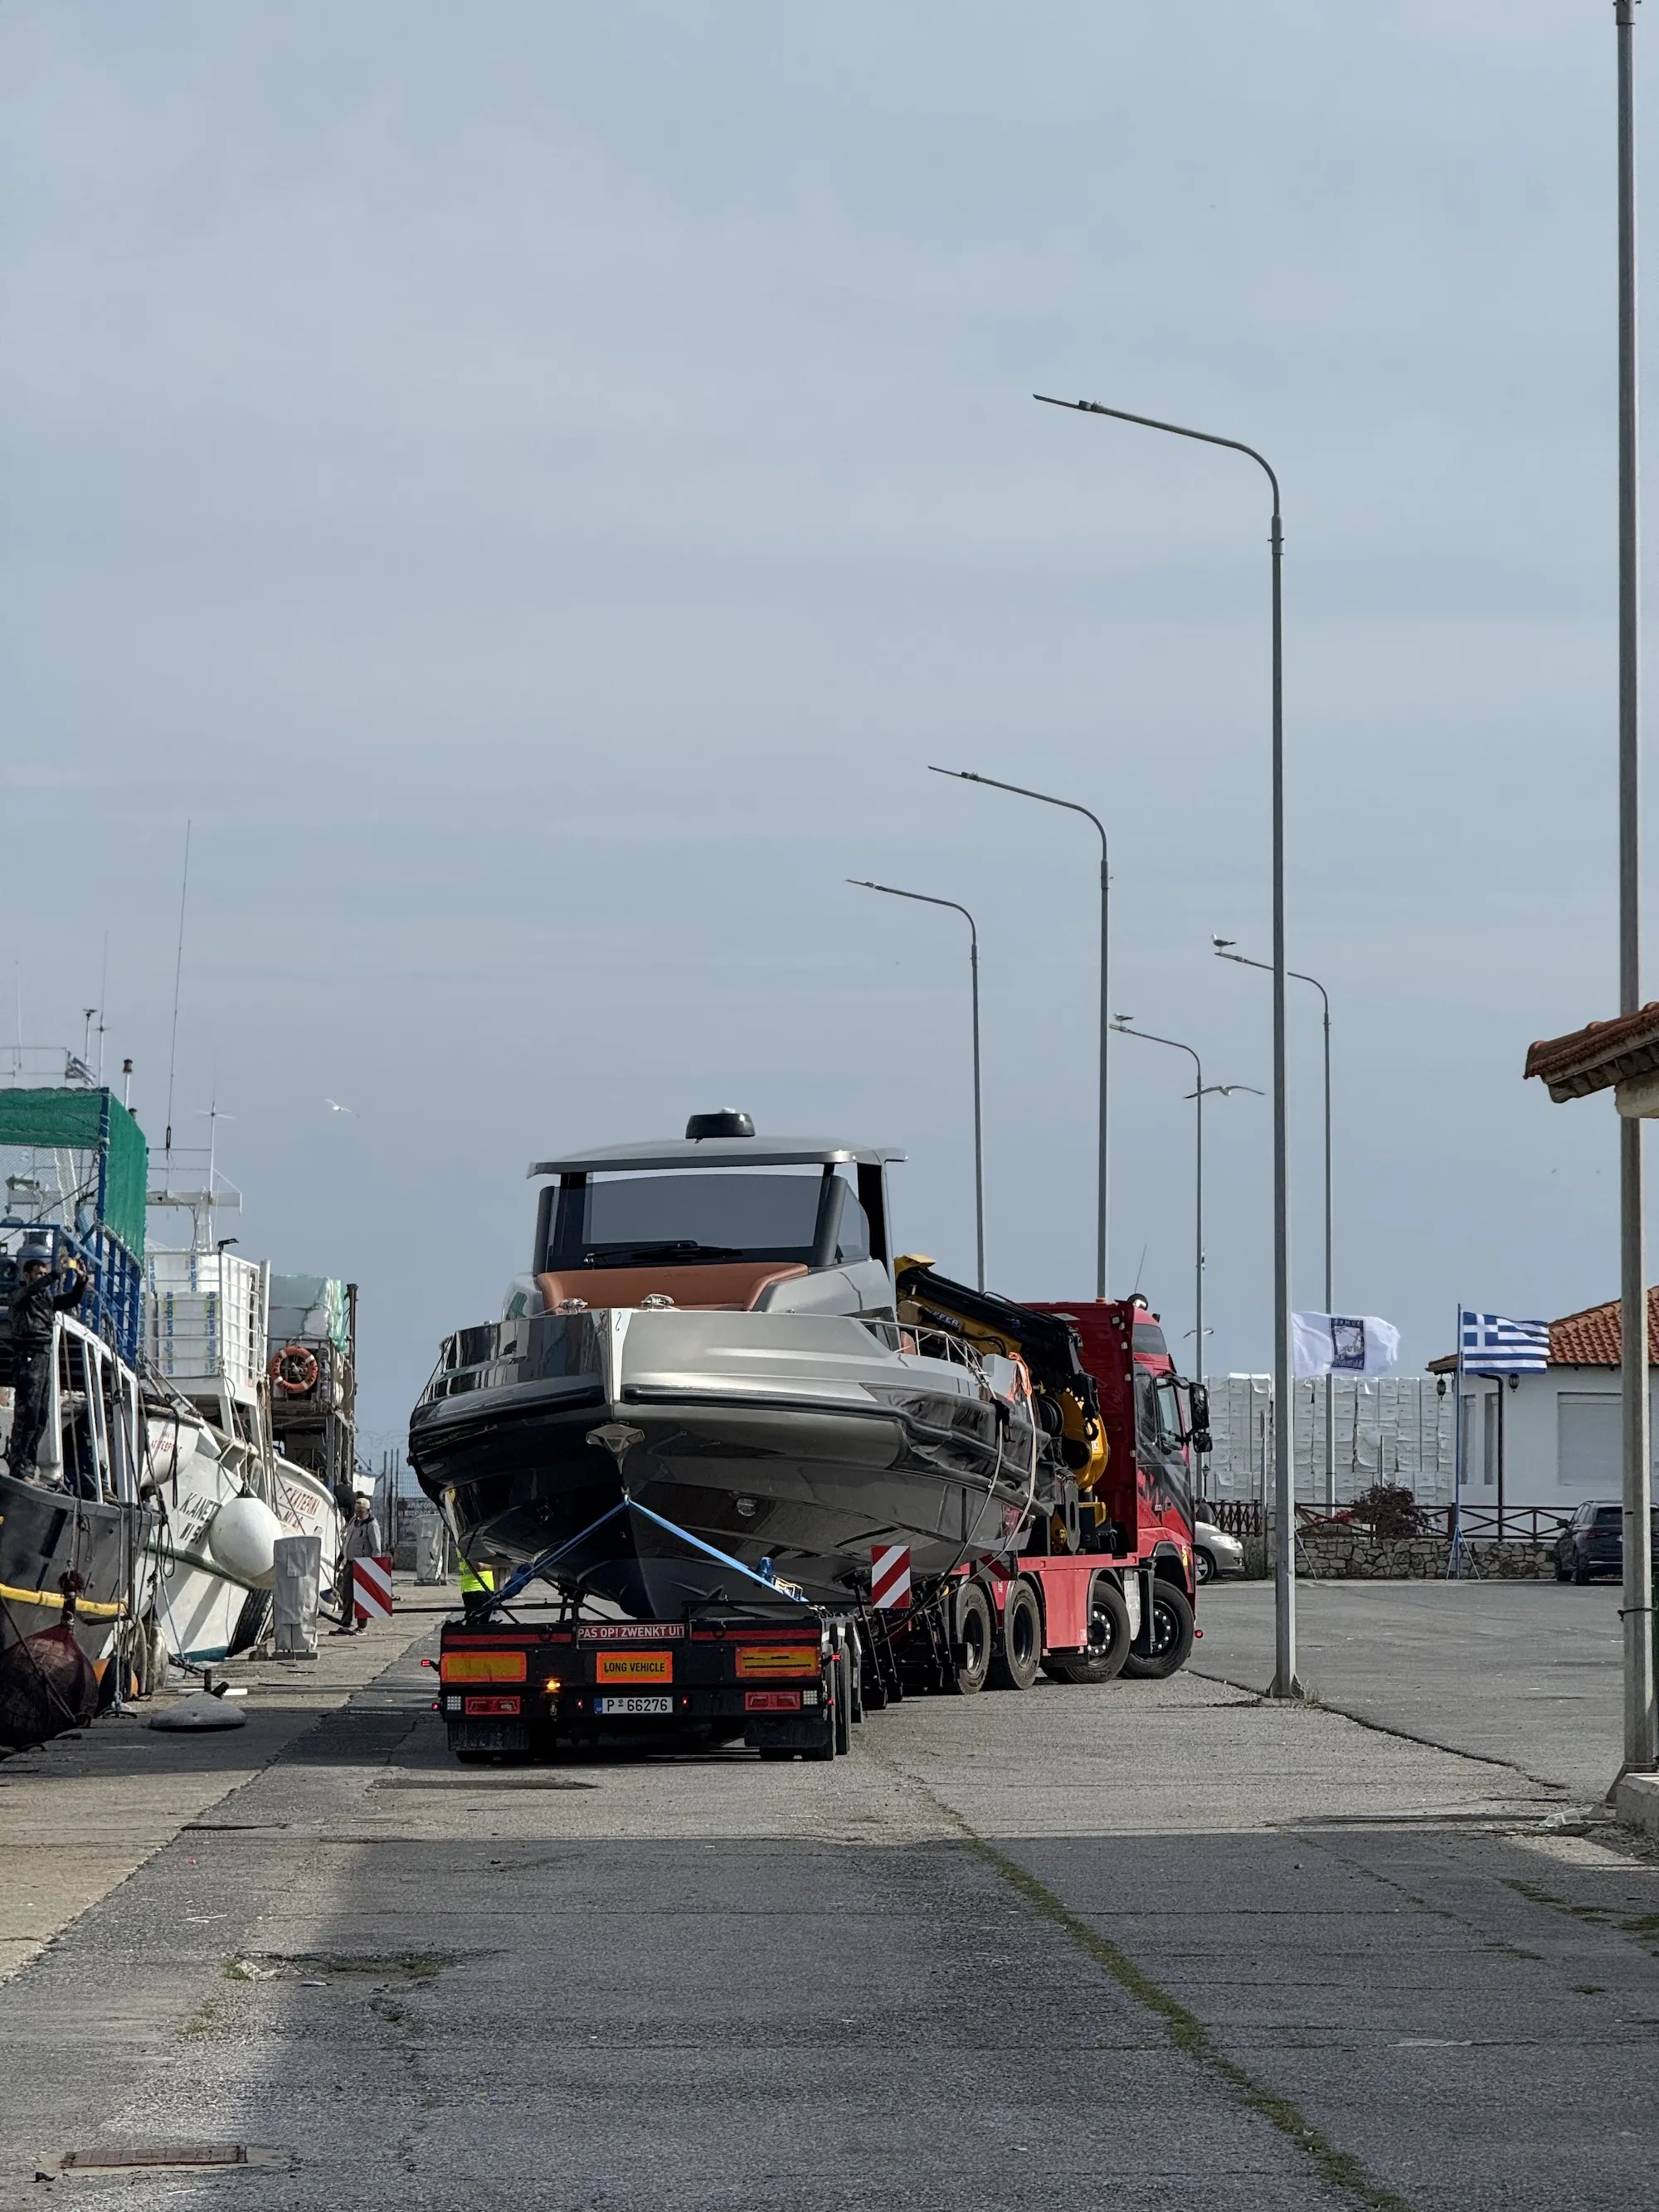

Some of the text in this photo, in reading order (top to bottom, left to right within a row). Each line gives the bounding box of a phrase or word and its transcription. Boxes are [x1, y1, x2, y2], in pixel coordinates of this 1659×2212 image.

[577, 1627, 597, 1638] PAS
[600, 1627, 619, 1638] OP!
[621, 1626, 666, 1637] ZWENKT
[604, 1662, 665, 1673] LONG VEHICLE
